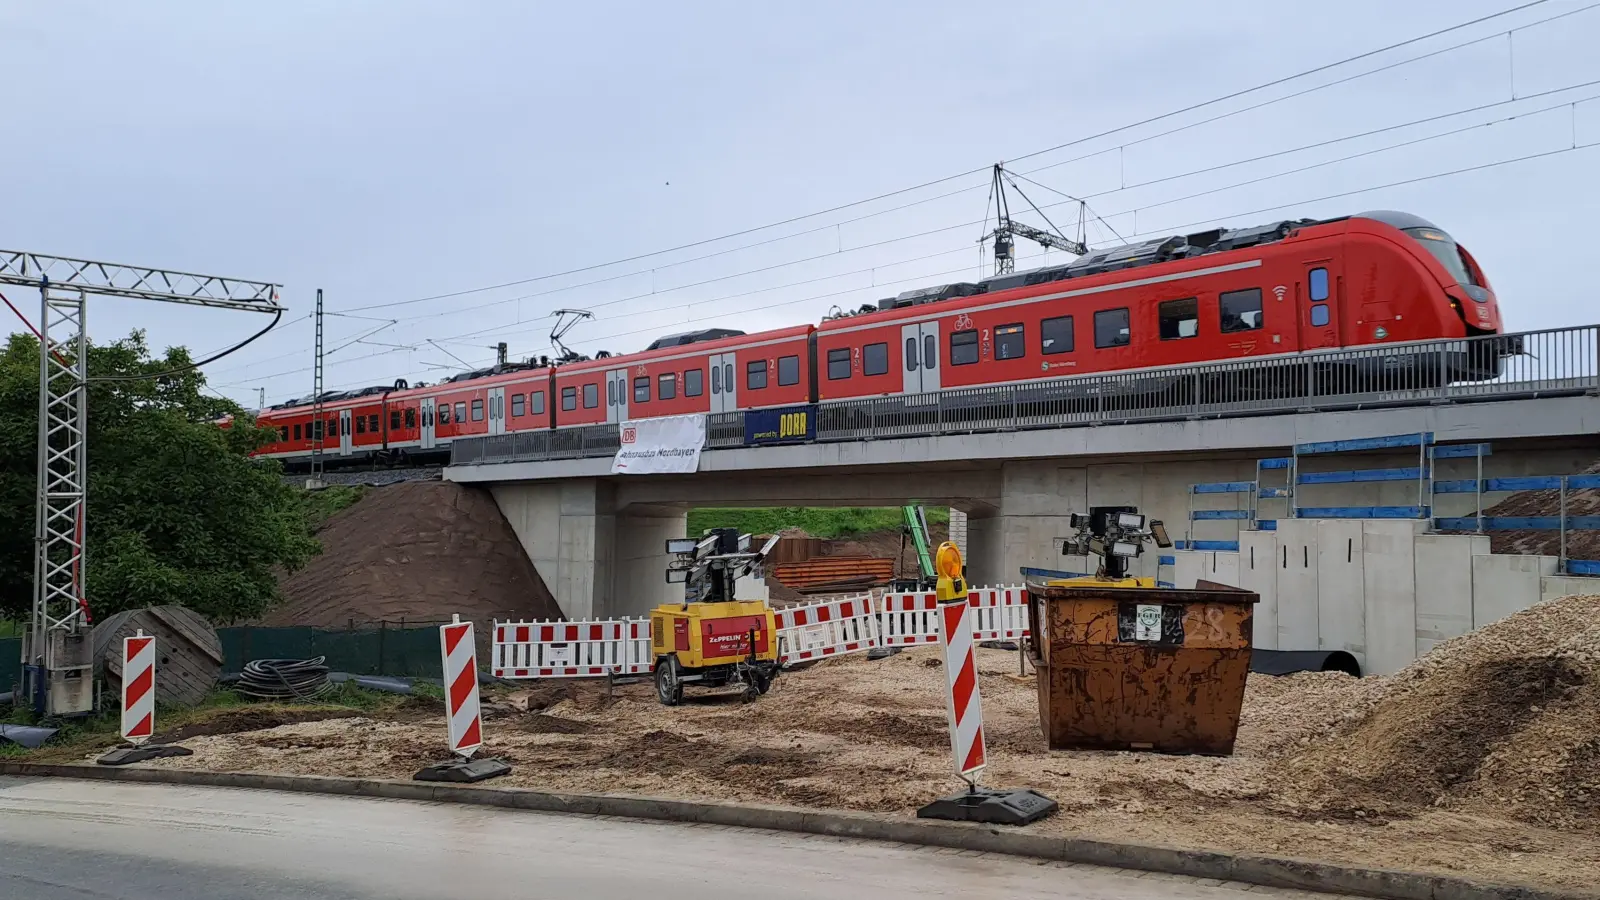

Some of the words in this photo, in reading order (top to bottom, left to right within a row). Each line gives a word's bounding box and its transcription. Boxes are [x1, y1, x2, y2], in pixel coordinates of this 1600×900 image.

[983, 329, 989, 341] 2
[854, 347, 859, 358] 2
[770, 359, 775, 369] 2
[677, 372, 682, 381] 2
[780, 412, 807, 438] PORR
[624, 430, 635, 442] DB
